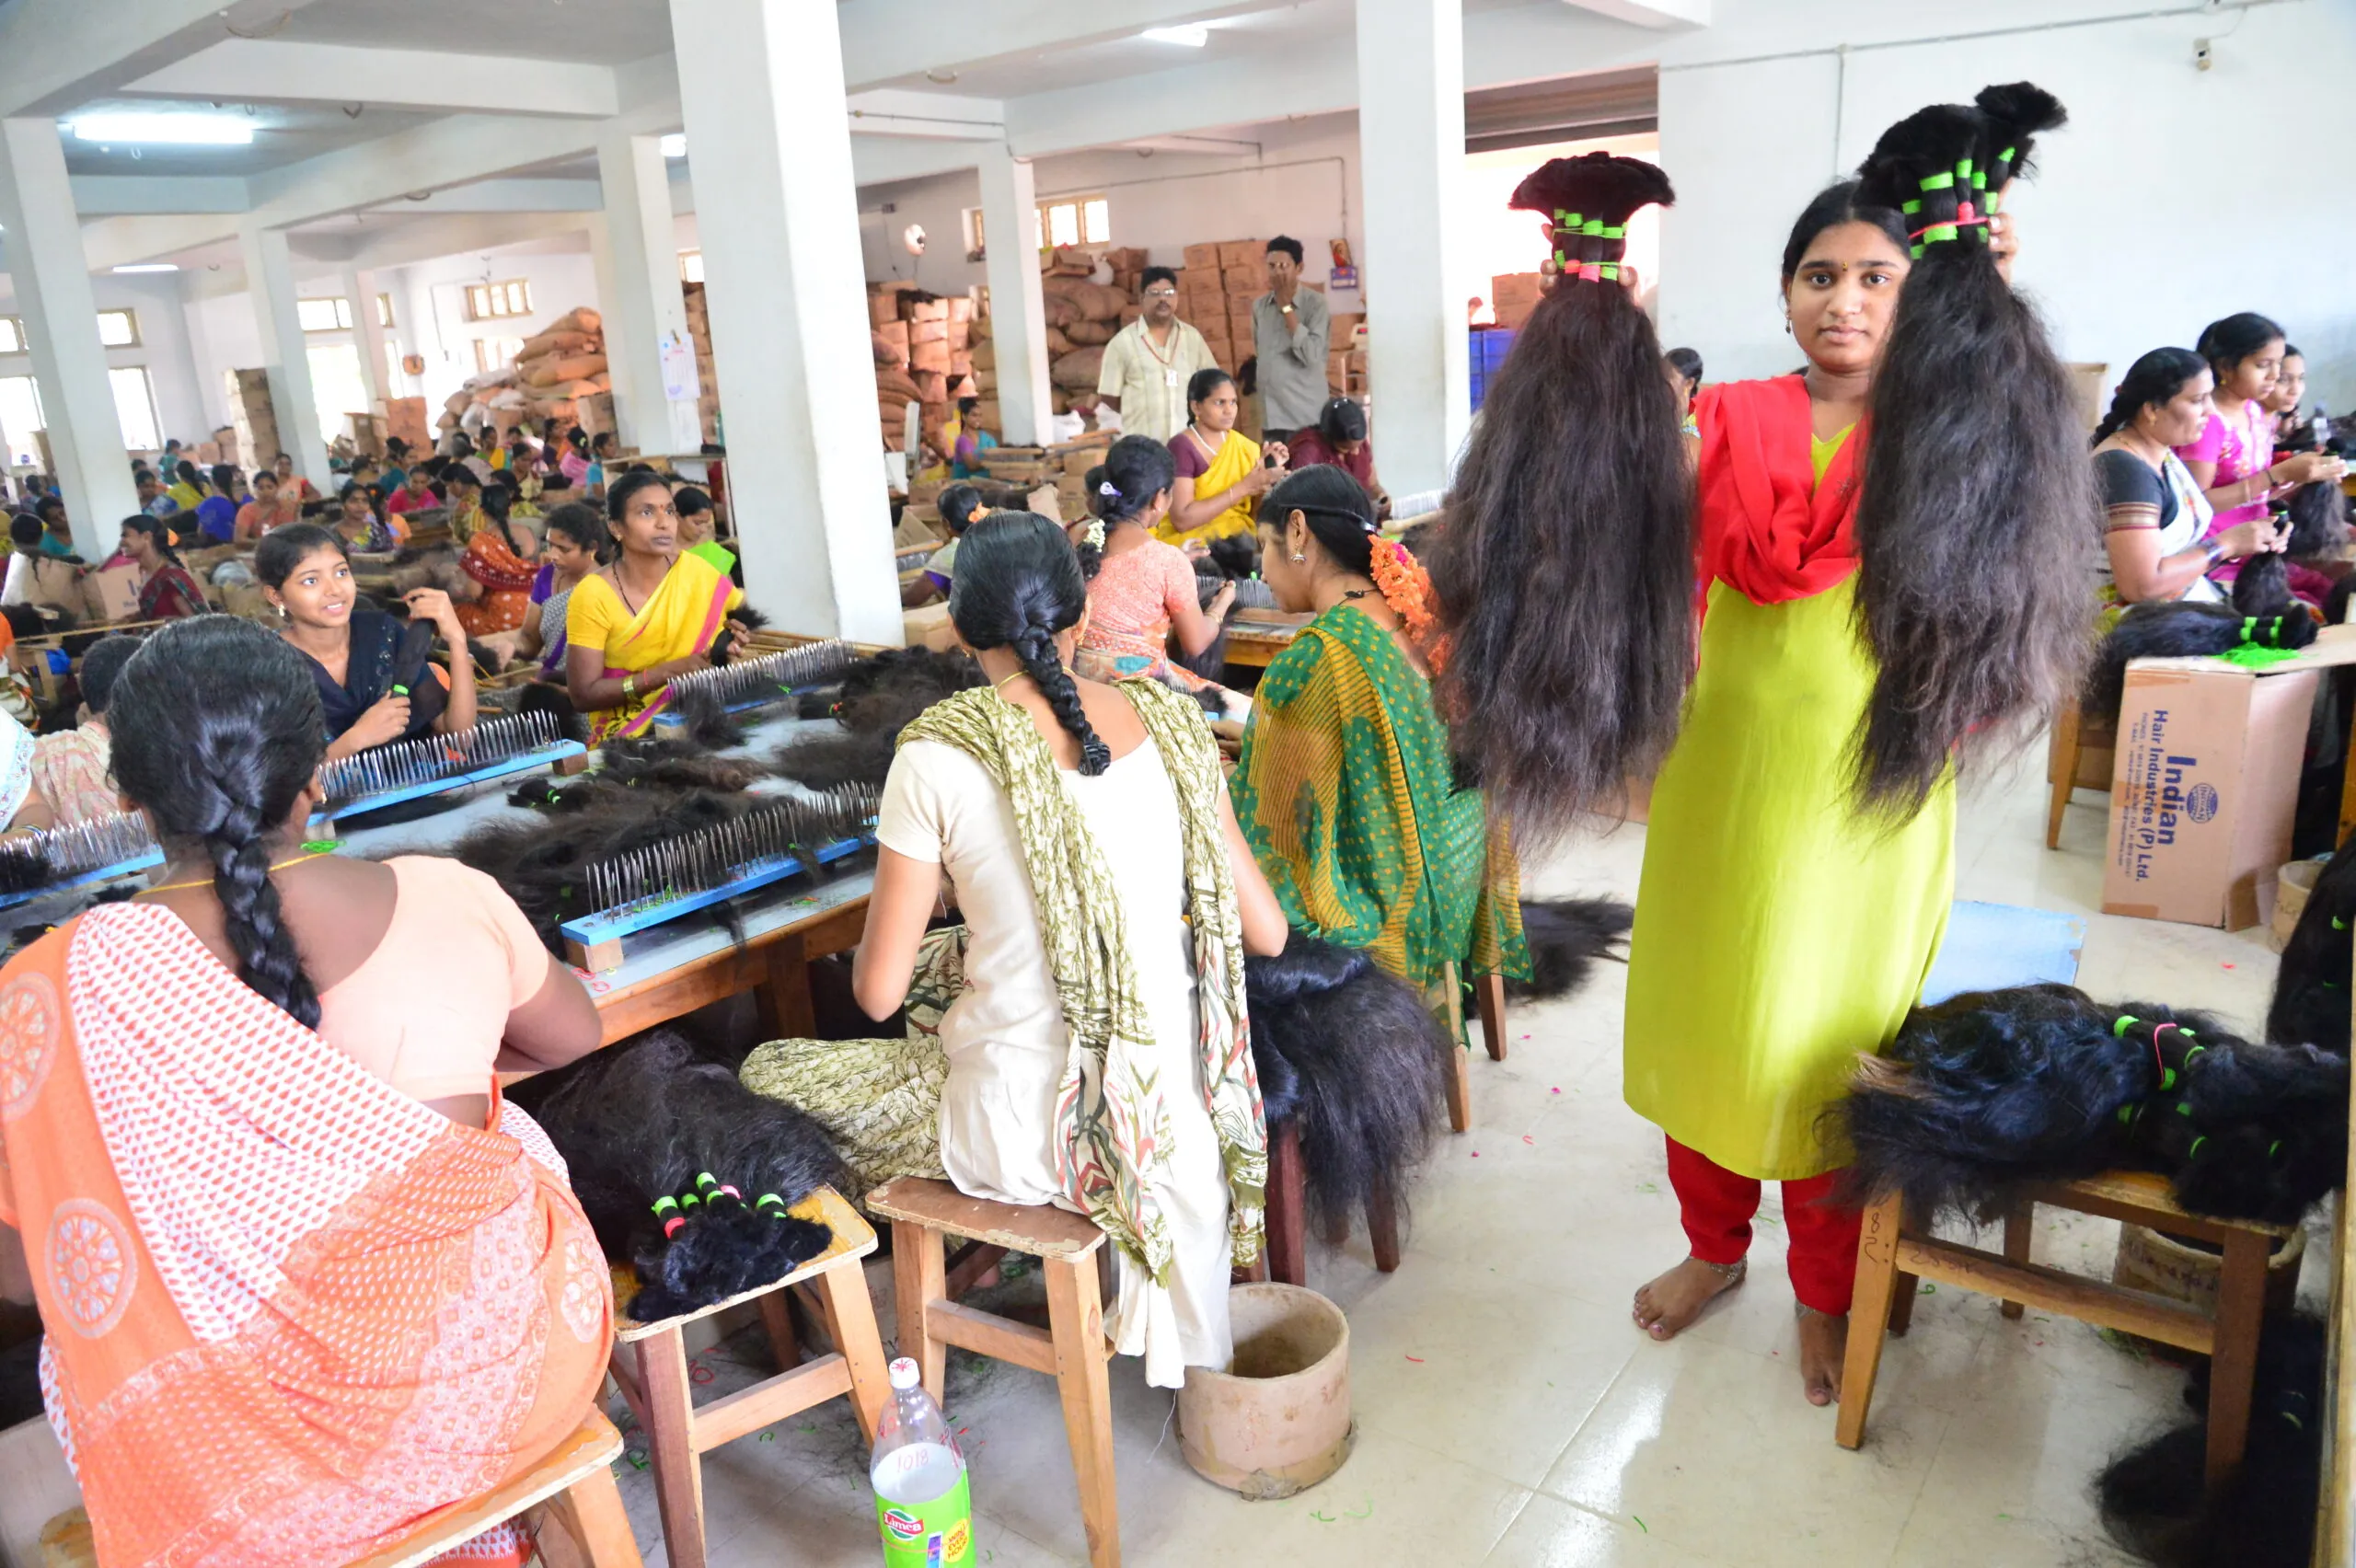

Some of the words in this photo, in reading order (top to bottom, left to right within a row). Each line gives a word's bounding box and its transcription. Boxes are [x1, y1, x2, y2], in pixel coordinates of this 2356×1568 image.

[2151, 709, 2168, 744] Hair
[2142, 747, 2165, 824] Industries
[2157, 755, 2197, 845] Indian
[2135, 827, 2155, 849] (P)
[2135, 853, 2154, 882] Ltd.
[896, 1448, 929, 1473] 1018
[884, 1512, 923, 1532] Limca
